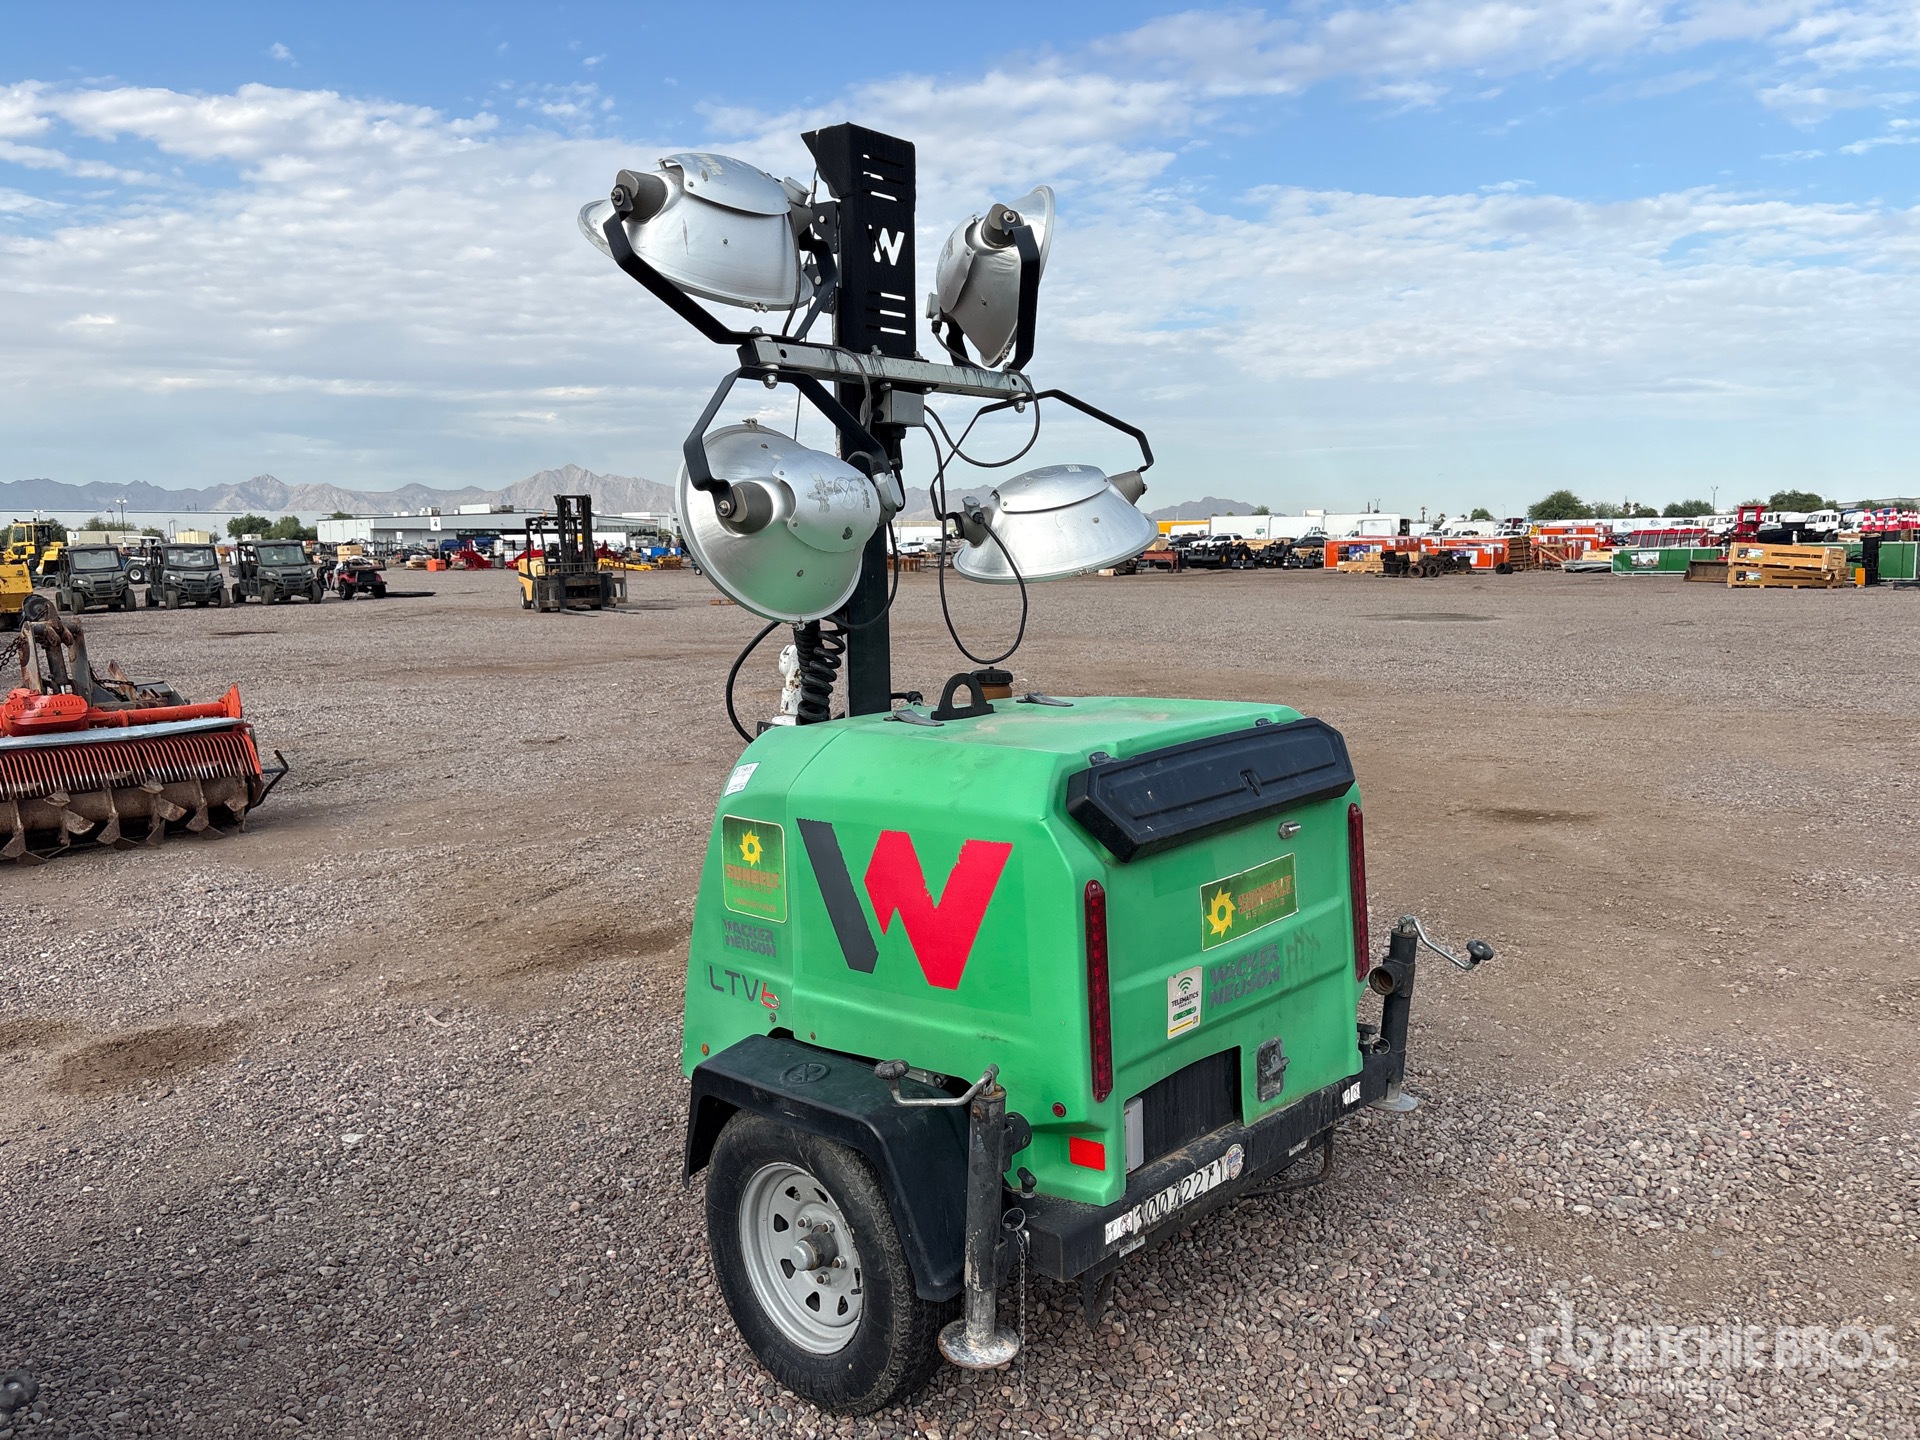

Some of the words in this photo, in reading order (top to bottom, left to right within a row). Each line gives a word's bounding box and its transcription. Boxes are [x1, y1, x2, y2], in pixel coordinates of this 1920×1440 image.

[725, 863, 780, 889] SUNBELT
[1237, 875, 1292, 915] SUNBELT
[722, 918, 775, 943] WACKER
[725, 933, 777, 959] NEUSON
[1209, 943, 1280, 986] WACKER
[709, 965, 780, 1010] LTV6
[1171, 991, 1199, 1008] TELEMATICS
[1209, 965, 1281, 1009] NEUSON
